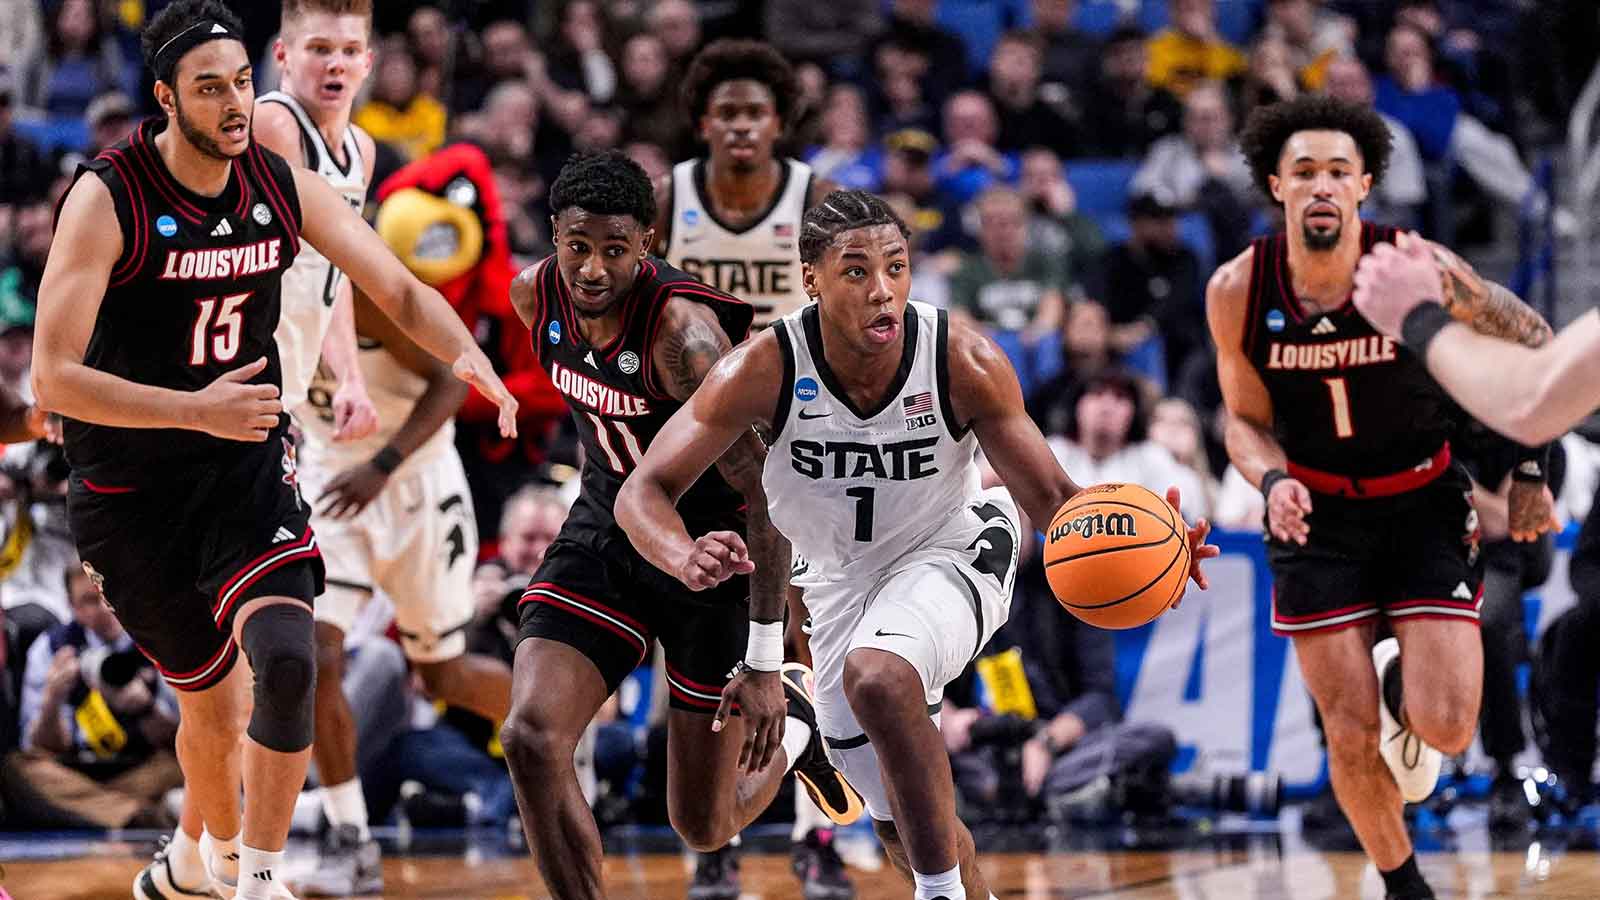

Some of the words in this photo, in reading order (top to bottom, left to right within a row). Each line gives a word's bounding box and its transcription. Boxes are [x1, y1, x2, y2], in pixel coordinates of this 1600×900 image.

[162, 238, 281, 280] LOUISVILLE
[681, 258, 792, 293] STATE
[191, 293, 252, 365] 15
[1268, 335, 1396, 370] LOUISVILLE
[552, 361, 650, 416] LOUISVILLE
[797, 387, 817, 397] NCAA
[1323, 377, 1353, 438] 1
[586, 412, 645, 473] 11
[790, 436, 940, 481] STATE
[846, 486, 875, 542] 1
[1050, 512, 1137, 544] Wilson
